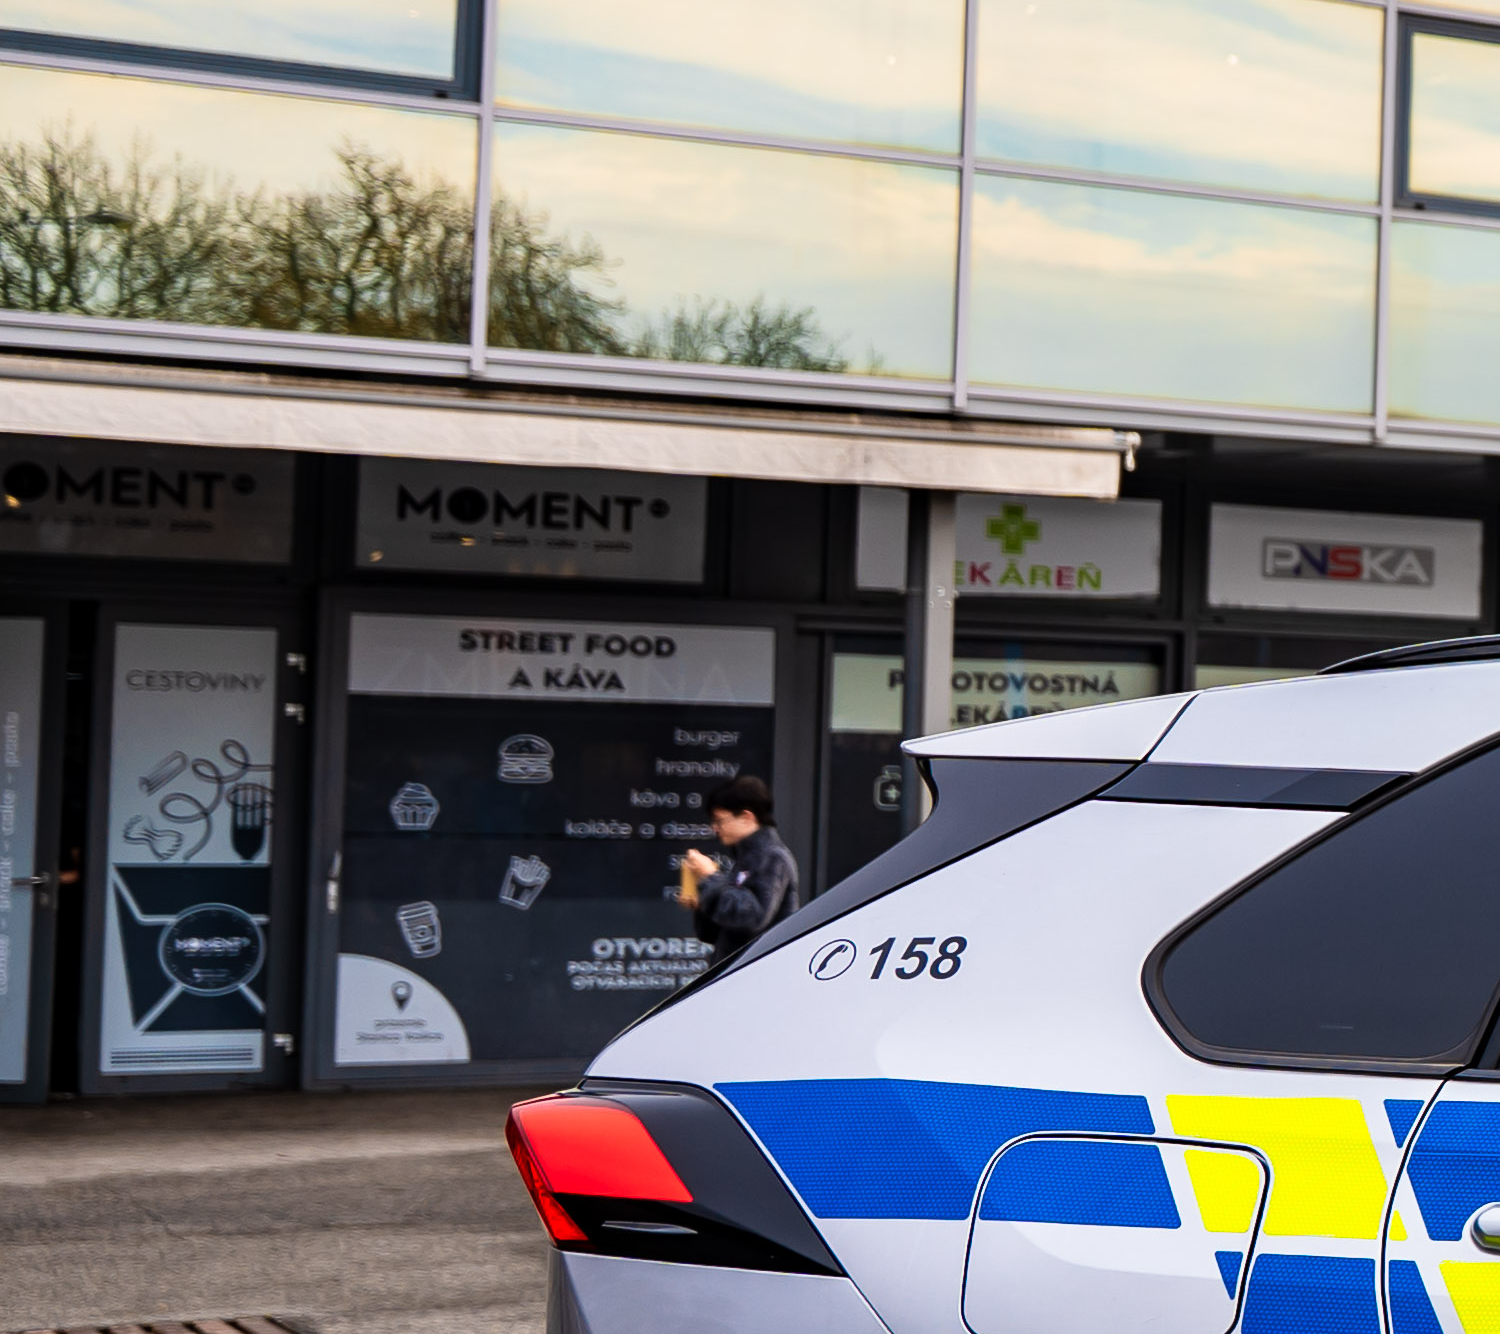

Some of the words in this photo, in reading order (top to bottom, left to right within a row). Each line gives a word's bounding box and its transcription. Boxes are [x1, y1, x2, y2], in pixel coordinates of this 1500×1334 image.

[396, 483, 643, 534] MOMENT
[1264, 540, 1428, 584] PNSKA
[458, 627, 575, 656] STREET
[584, 633, 677, 659] FOOD
[125, 668, 266, 693] CESTOVINY
[508, 666, 533, 691] A
[542, 662, 626, 693] KÁVA
[673, 726, 742, 751] burger
[655, 757, 741, 780] hranolky
[629, 788, 681, 809] káva
[686, 791, 703, 809] a
[564, 817, 633, 839] koláče
[639, 821, 656, 839] a
[868, 935, 968, 980] 158
